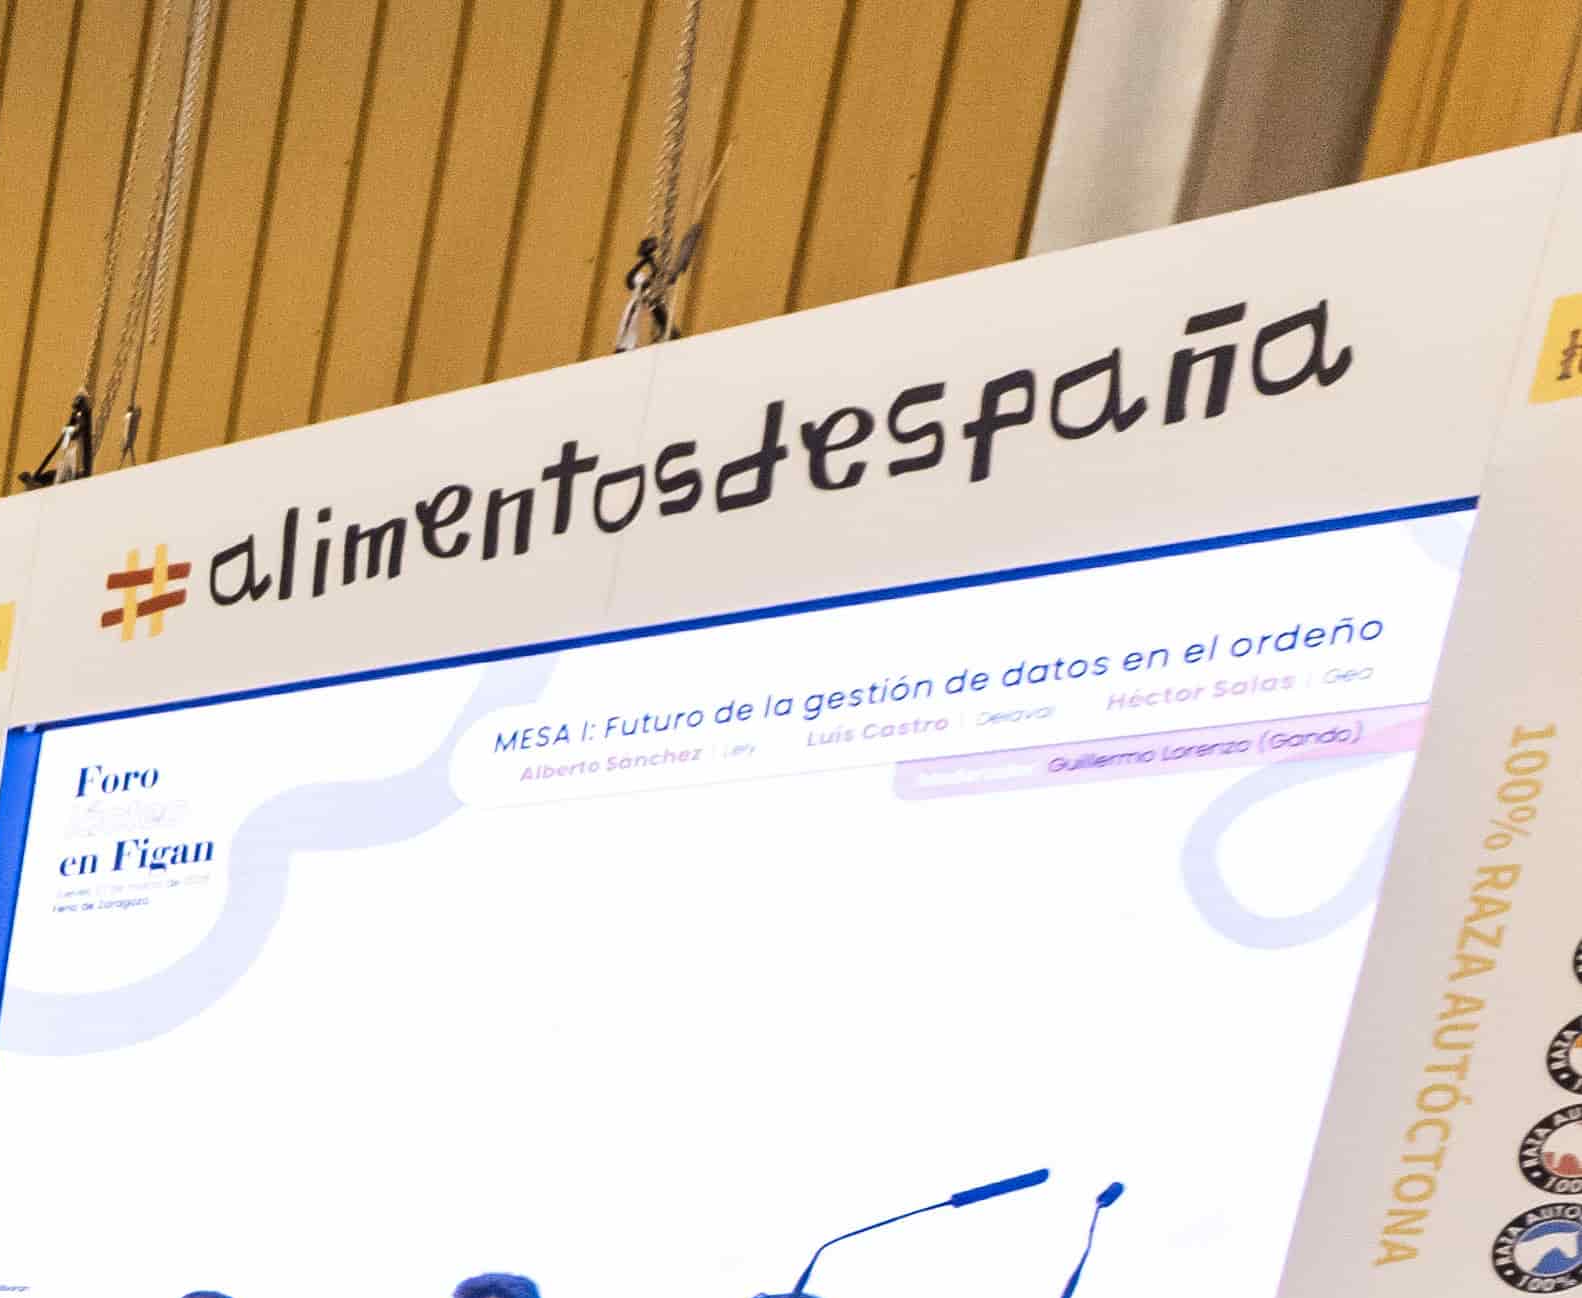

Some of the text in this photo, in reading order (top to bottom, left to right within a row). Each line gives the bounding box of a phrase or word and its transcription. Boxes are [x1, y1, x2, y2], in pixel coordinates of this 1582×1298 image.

[494, 721, 570, 754] MESA
[604, 706, 705, 740] Futuro
[715, 699, 755, 725] de
[764, 694, 793, 719] la
[803, 674, 935, 722] gestión
[945, 666, 990, 696] de
[1002, 654, 1109, 689] datos
[1122, 646, 1169, 673] en
[1184, 632, 1218, 664] el
[1230, 616, 1385, 659] ordeño
[1212, 671, 1297, 699] Salas
[860, 715, 948, 742] Castro
[74, 763, 160, 798] Foro
[519, 759, 602, 783] Alberto
[59, 836, 214, 877] en Figan
[1371, 722, 1556, 1268] 100% RAZA AUTÓCTONA
